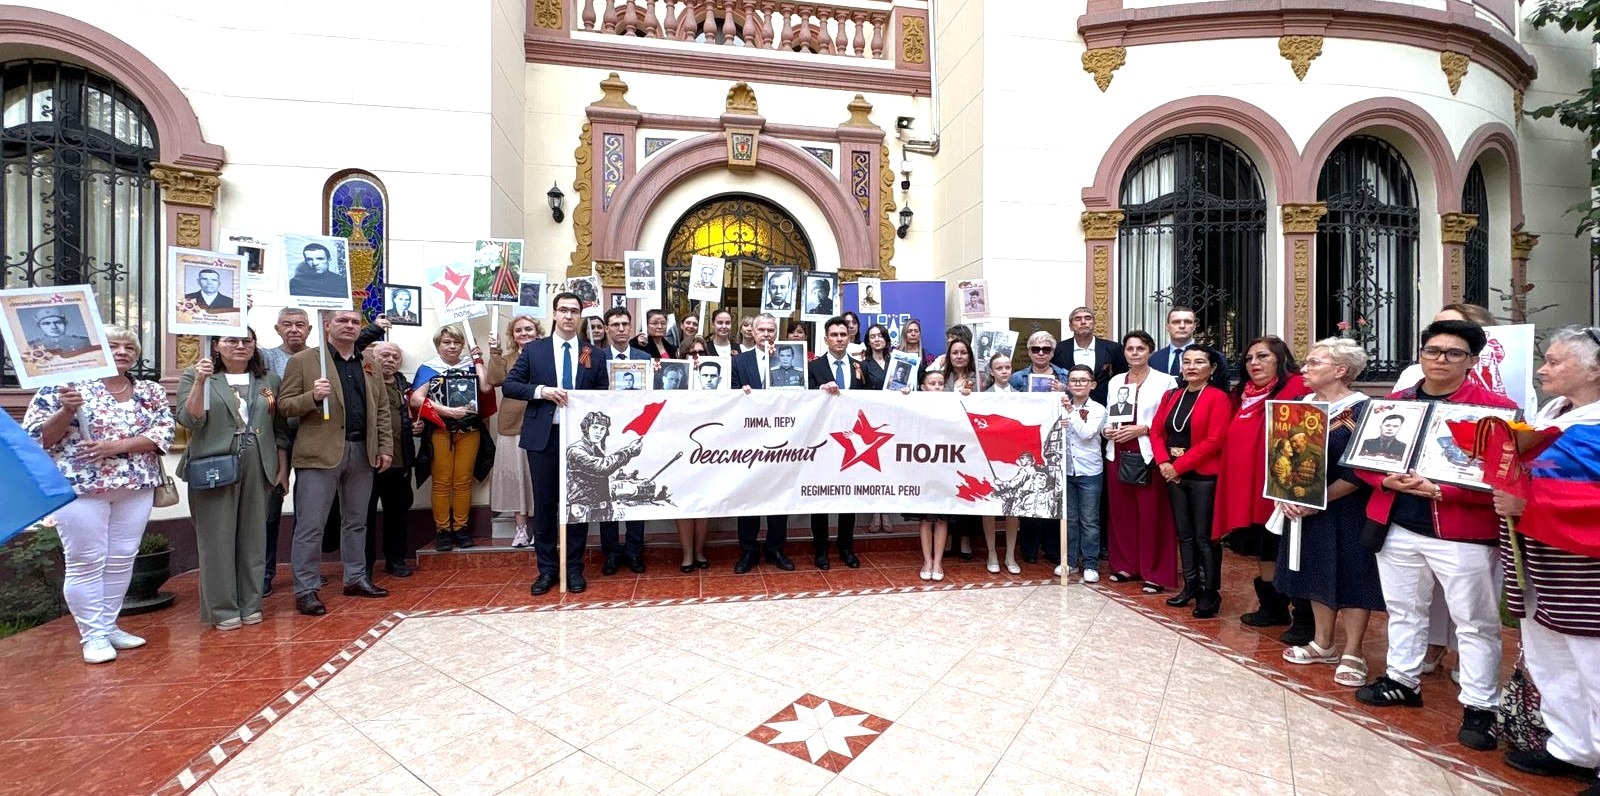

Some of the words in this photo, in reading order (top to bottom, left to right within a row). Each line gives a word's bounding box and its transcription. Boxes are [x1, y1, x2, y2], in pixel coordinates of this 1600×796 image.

[1279, 404, 1290, 422] 9
[743, 416, 771, 429] ЛИМА,
[774, 416, 796, 428] ПЕРУ
[689, 422, 828, 469] бессмертный
[895, 443, 967, 463] ПОЛК
[800, 484, 851, 497] REGIMIENTO
[853, 484, 896, 496] INMORTAL
[898, 484, 920, 497] PERU
